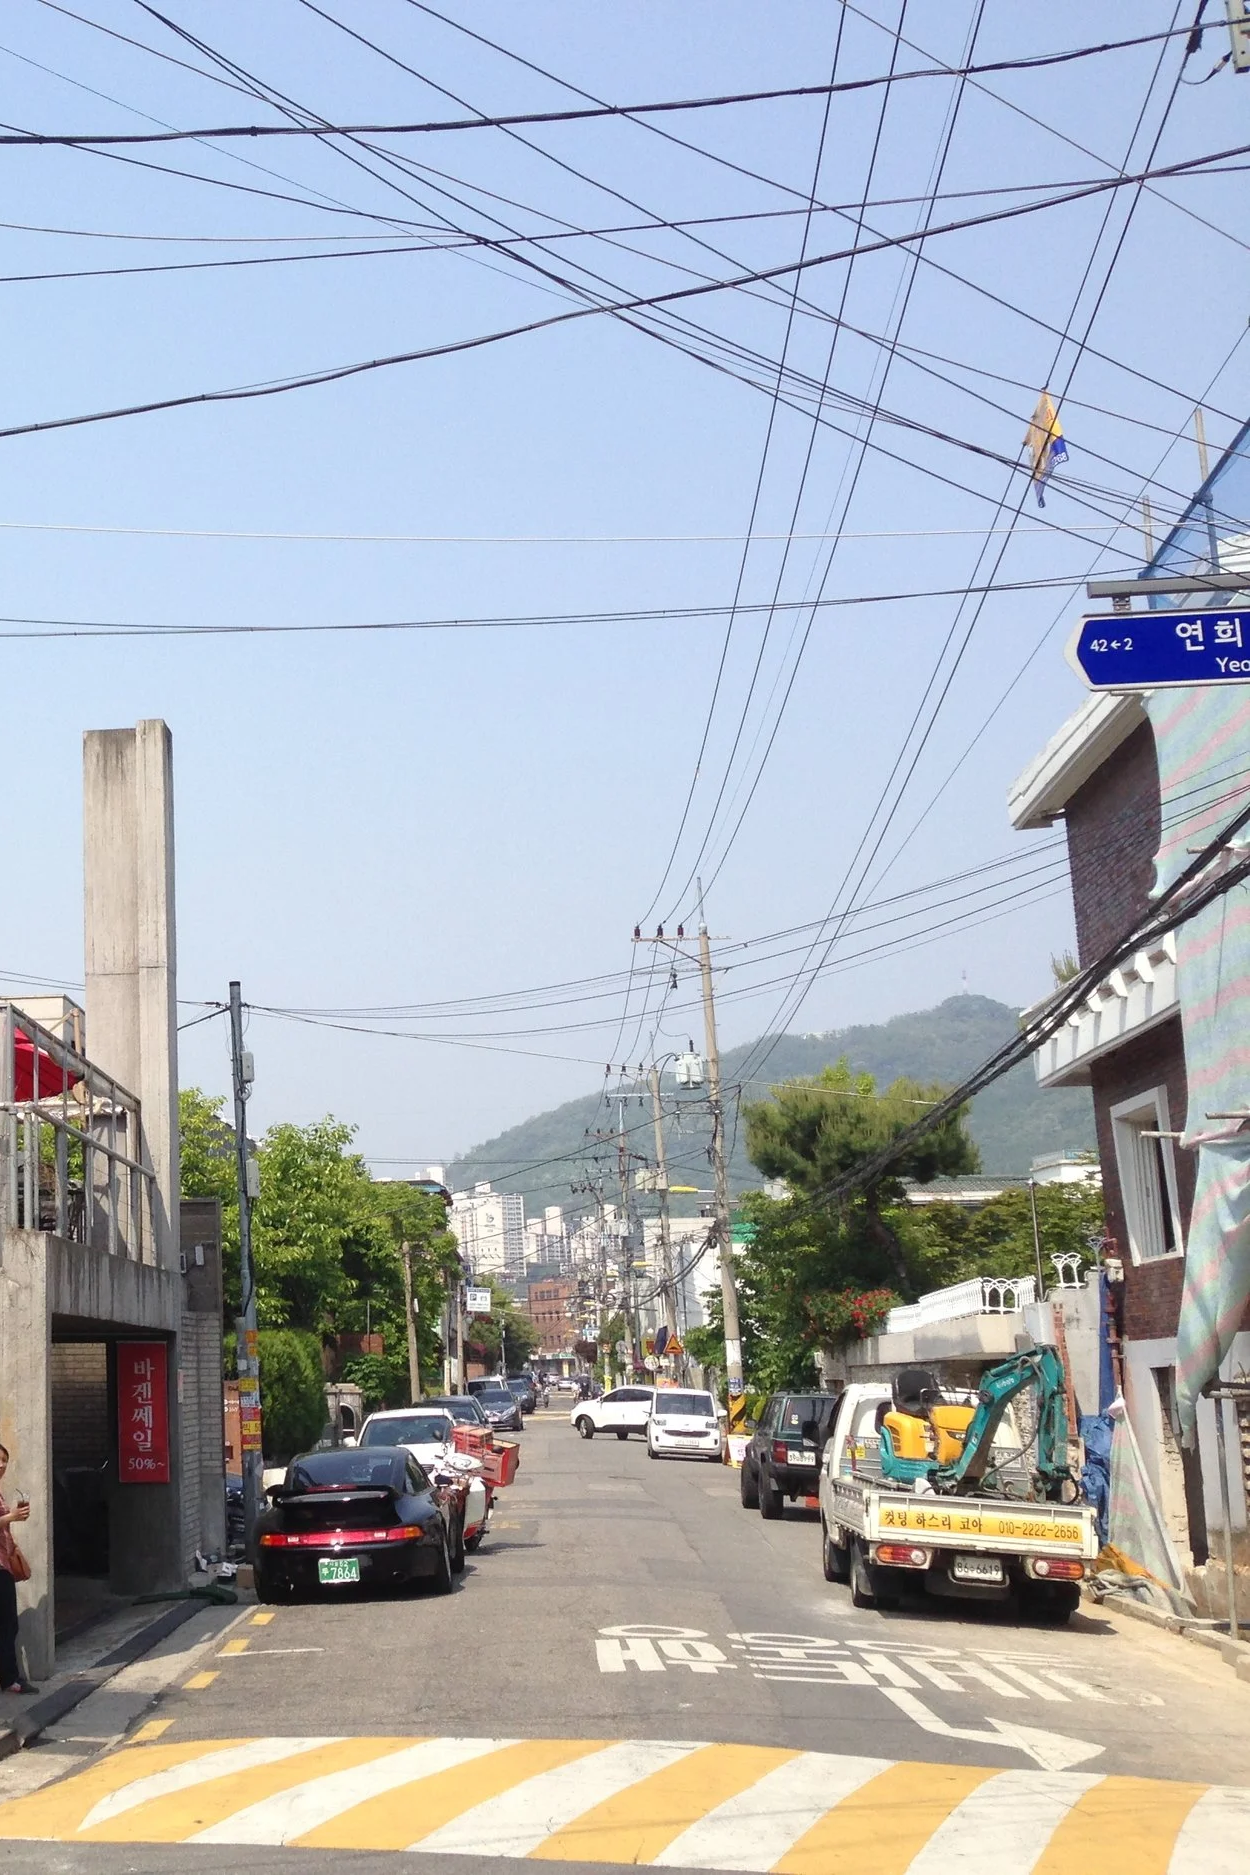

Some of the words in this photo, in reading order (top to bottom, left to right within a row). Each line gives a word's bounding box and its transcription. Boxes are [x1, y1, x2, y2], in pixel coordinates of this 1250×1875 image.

[916, 1513, 951, 1530] 하스리
[960, 1517, 982, 1533] 코아
[999, 1520, 1079, 1540] 010-2222-2656
